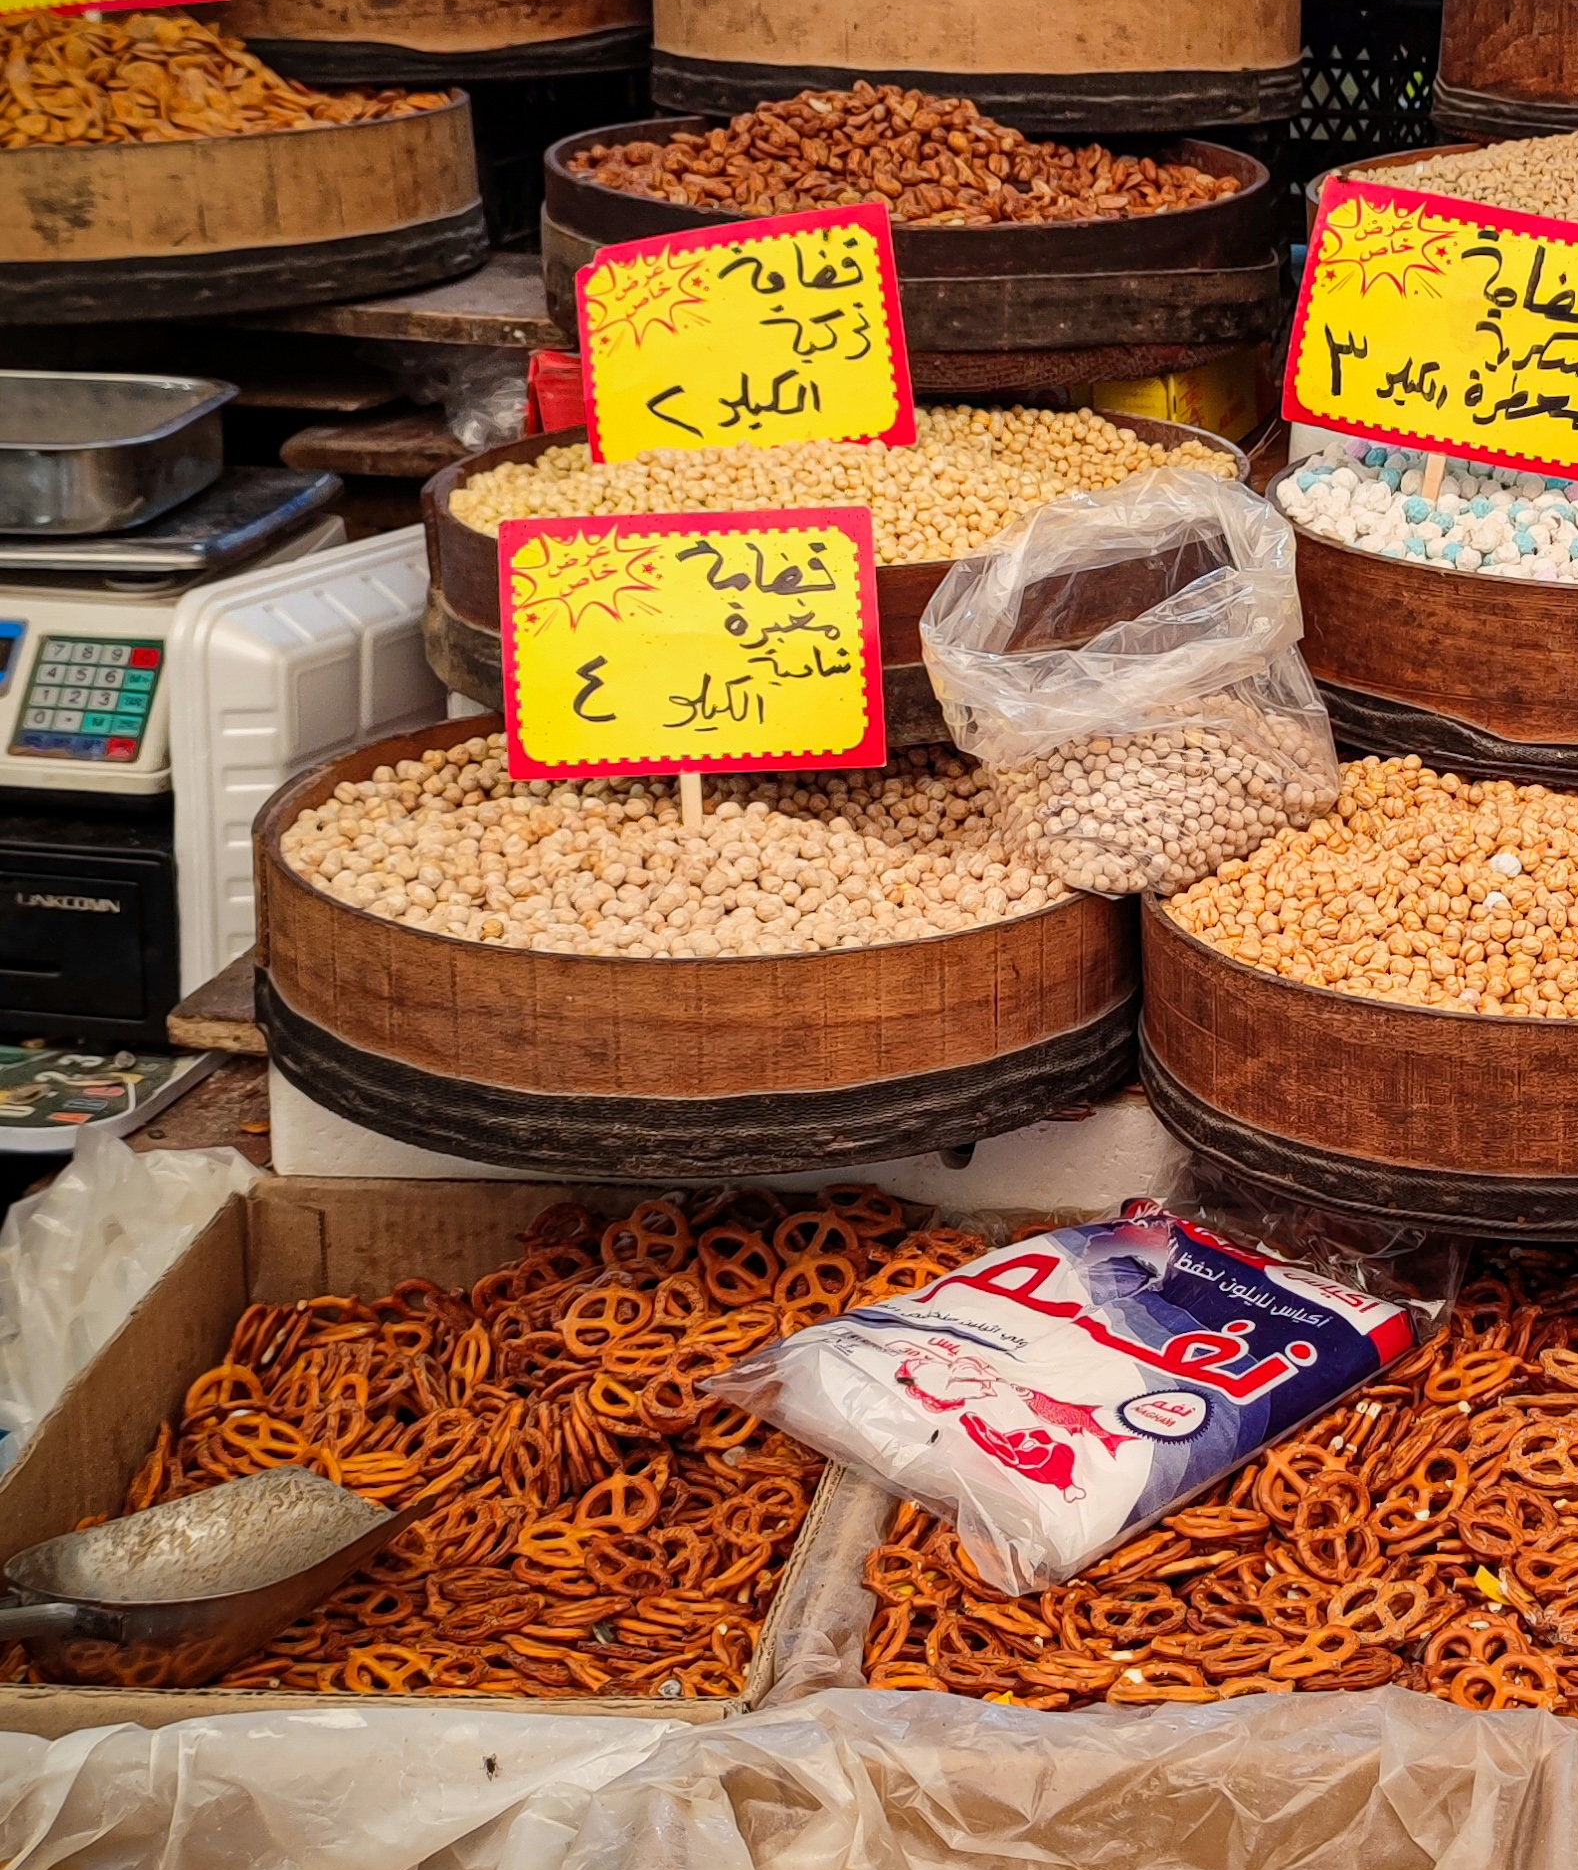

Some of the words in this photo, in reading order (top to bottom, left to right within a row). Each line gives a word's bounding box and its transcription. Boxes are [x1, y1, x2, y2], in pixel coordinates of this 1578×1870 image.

[1325, 322, 1368, 396] ٣
[718, 369, 823, 430] الكيلو
[573, 655, 617, 723] ٤
[662, 672, 766, 733] الكيلو
